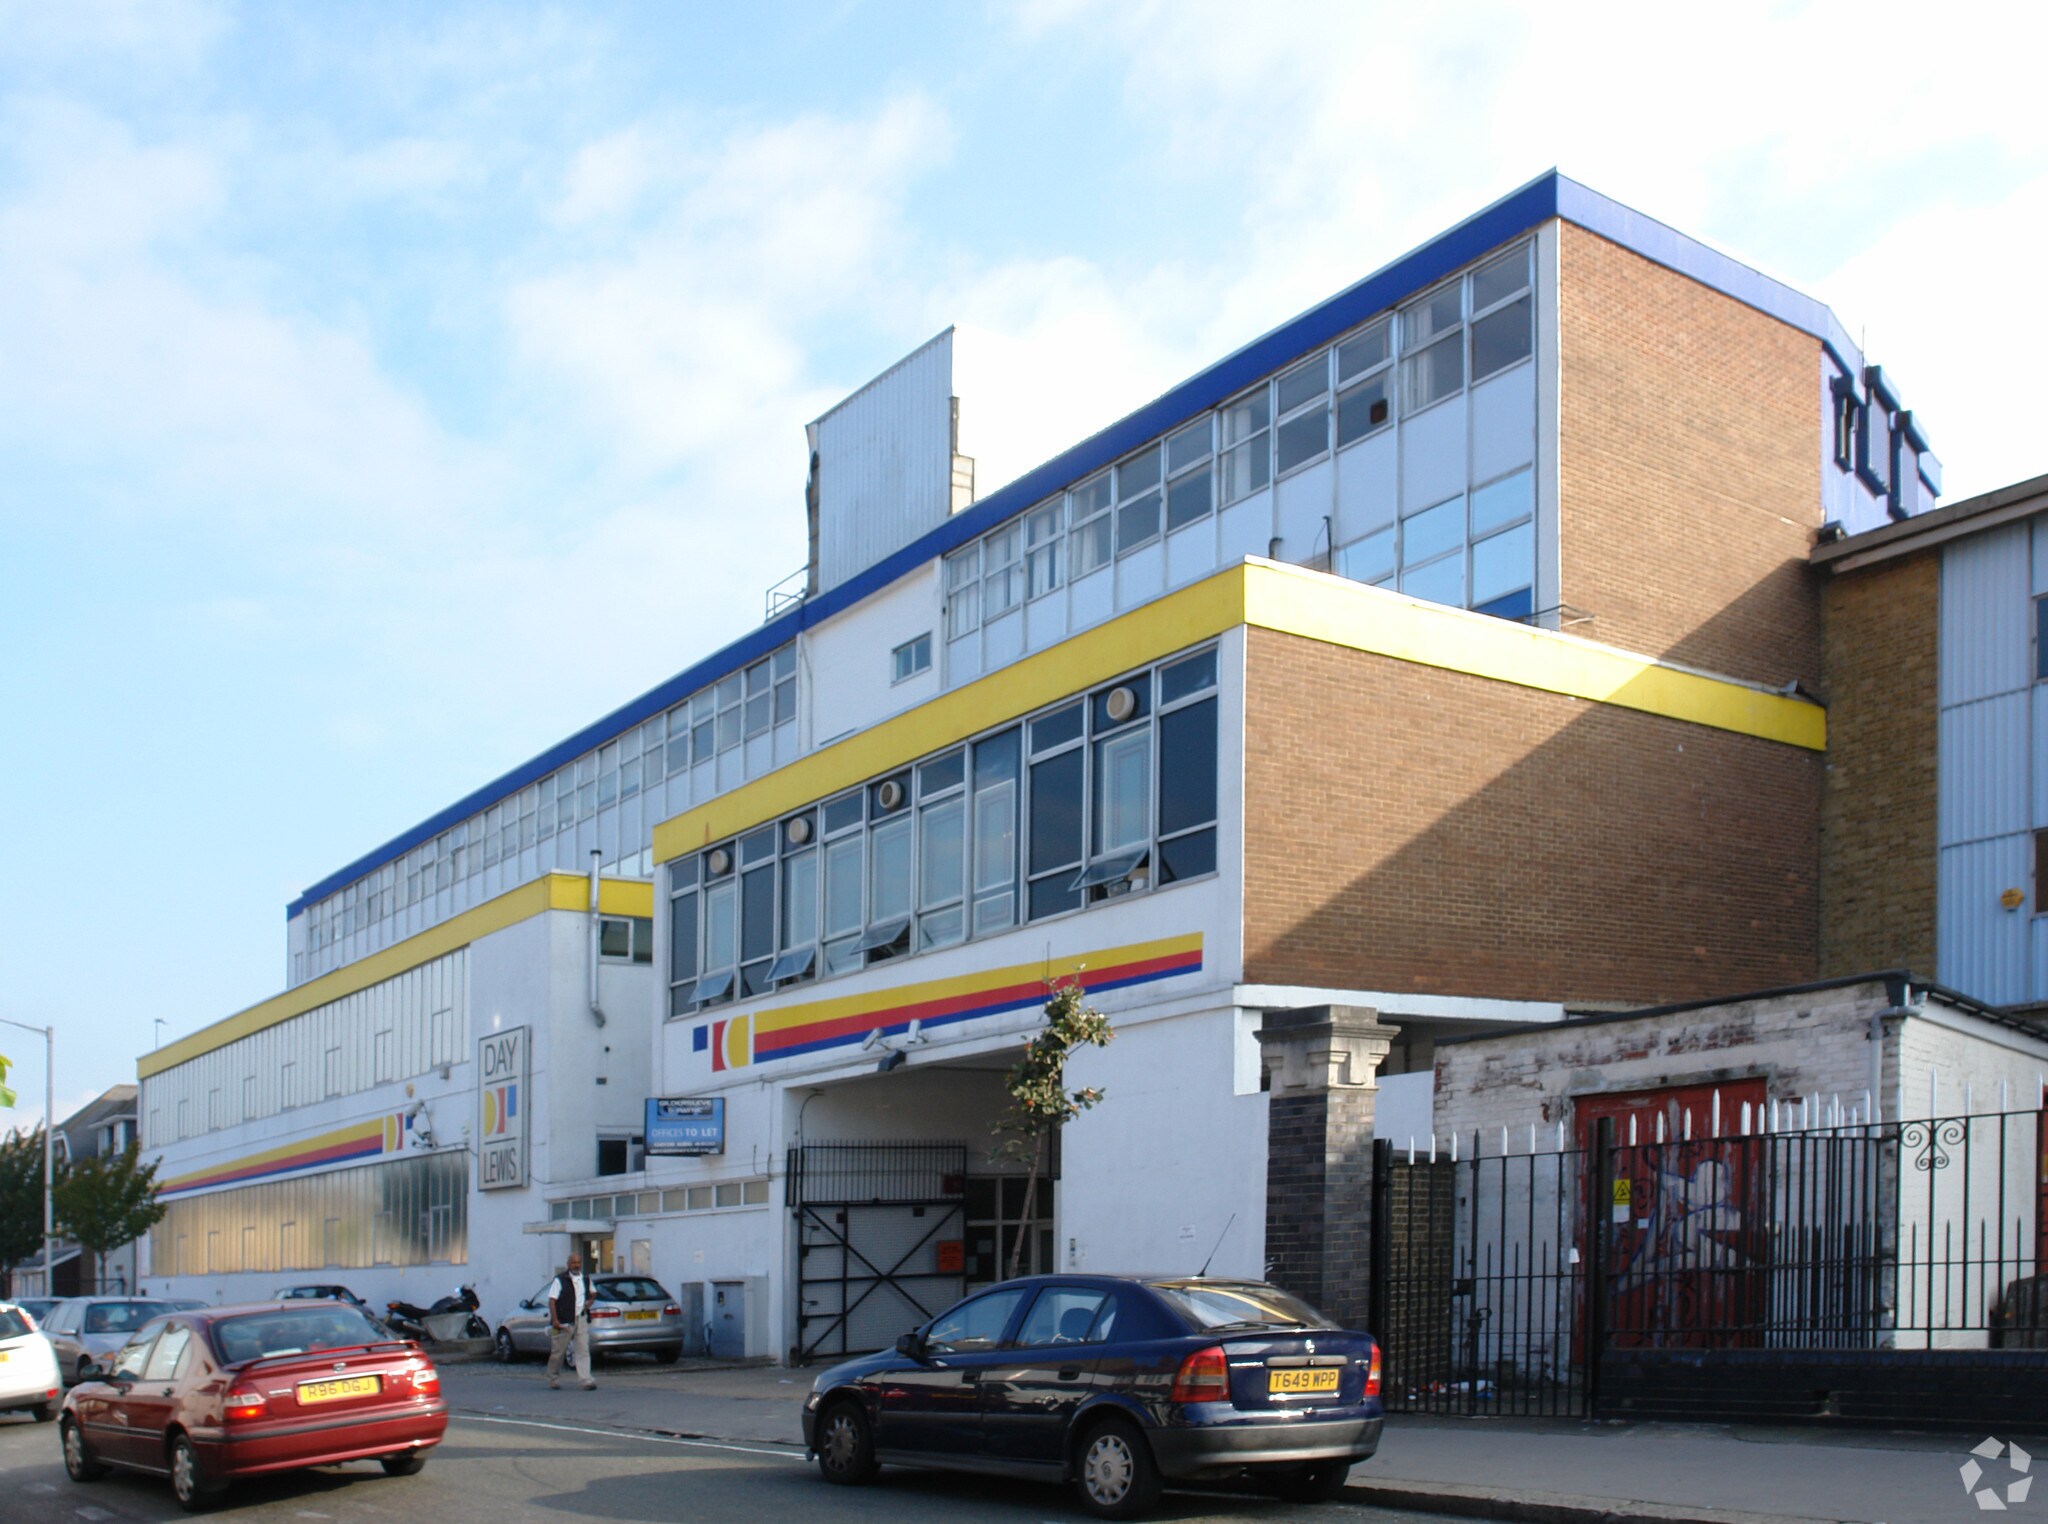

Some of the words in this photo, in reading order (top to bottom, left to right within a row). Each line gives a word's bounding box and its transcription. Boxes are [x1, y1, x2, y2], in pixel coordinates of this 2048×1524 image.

[484, 1036, 518, 1077] DAY
[651, 1127, 684, 1137] OFFICES
[685, 1127, 698, 1137] TO
[701, 1127, 718, 1137] LET
[484, 1147, 517, 1184] LEWIS
[1273, 1372, 1310, 1388] T649
[1312, 1371, 1336, 1387] WPP
[308, 1384, 337, 1398] R96
